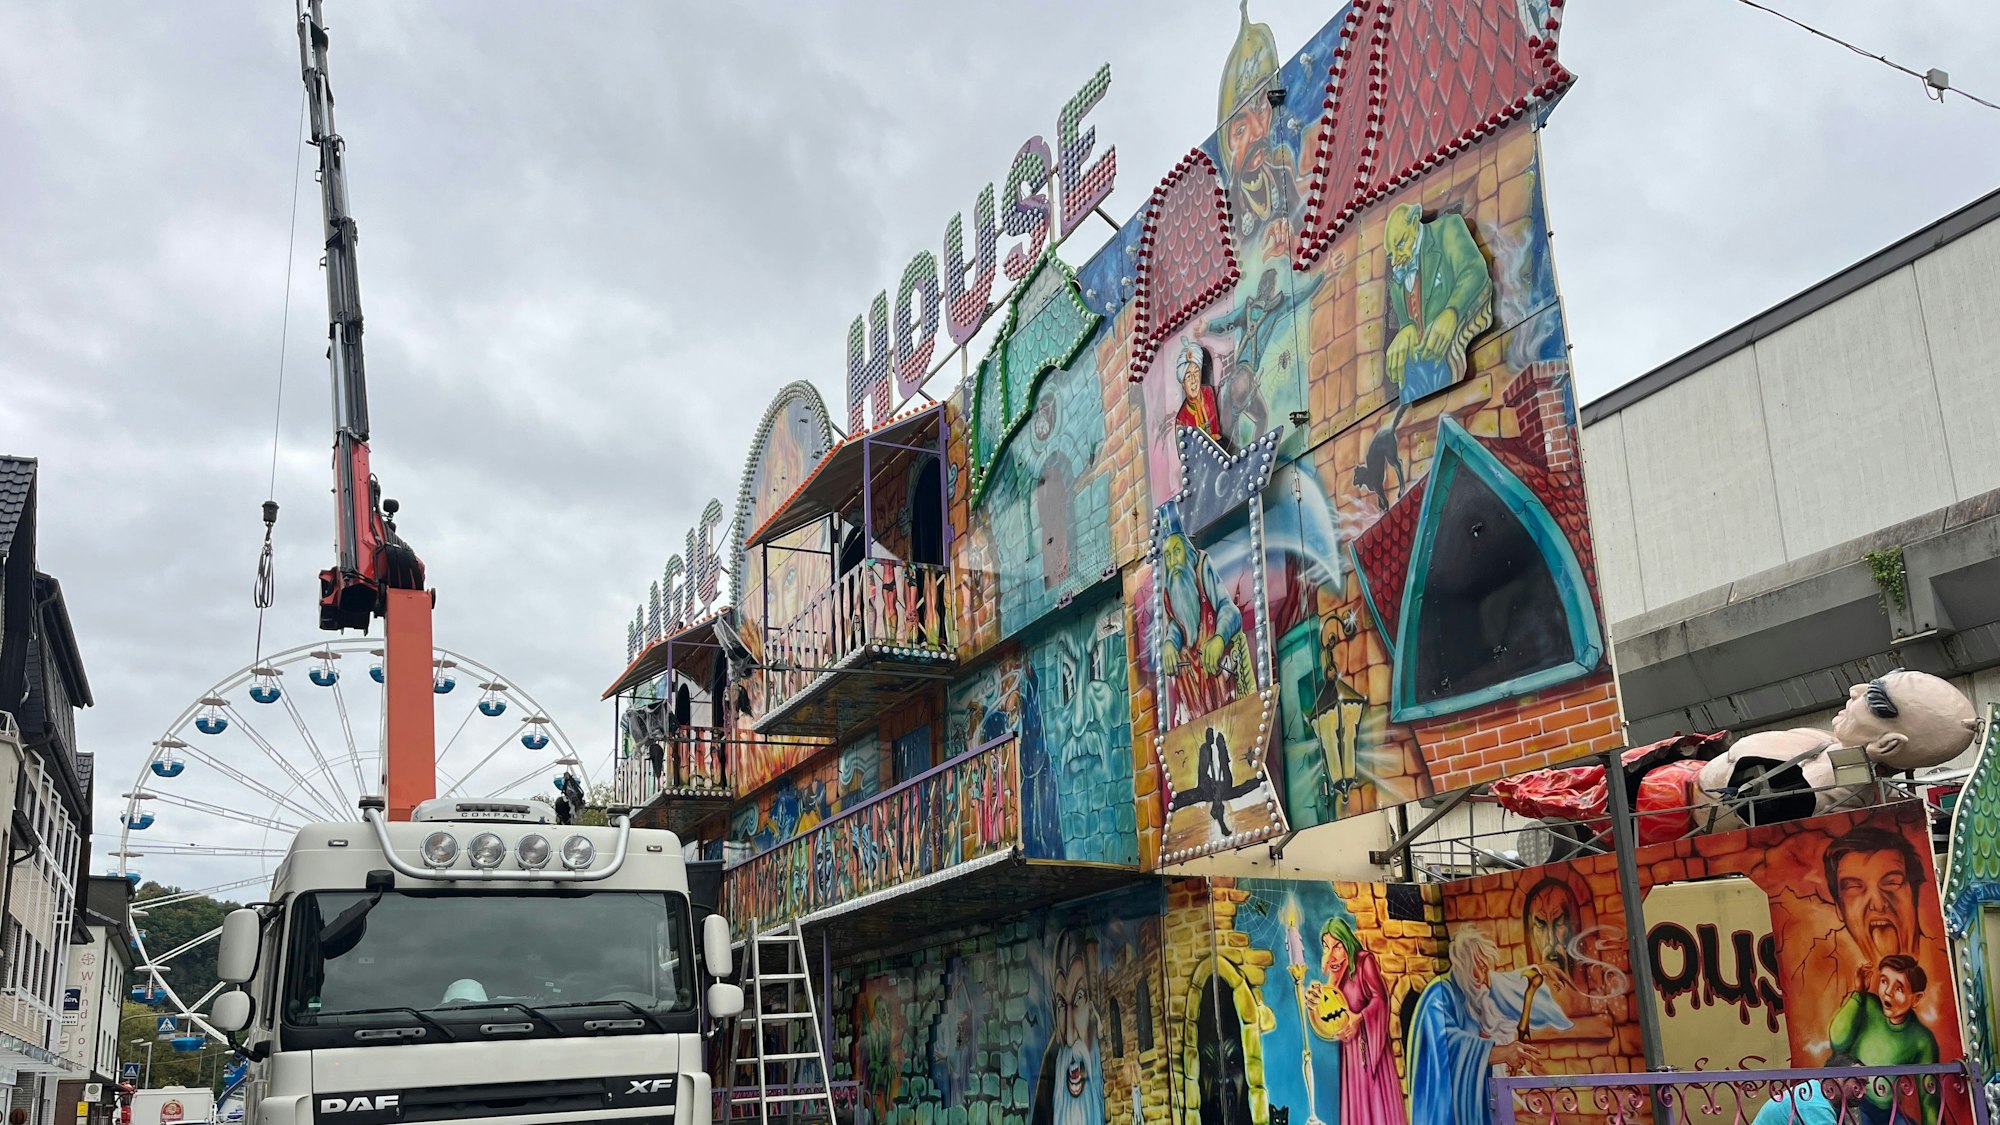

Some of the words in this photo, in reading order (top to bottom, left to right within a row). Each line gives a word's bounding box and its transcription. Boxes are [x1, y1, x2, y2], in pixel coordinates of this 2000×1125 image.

[847, 62, 1116, 438] HOUSE
[624, 1078, 673, 1095] XF
[320, 1095, 399, 1114] DAF
